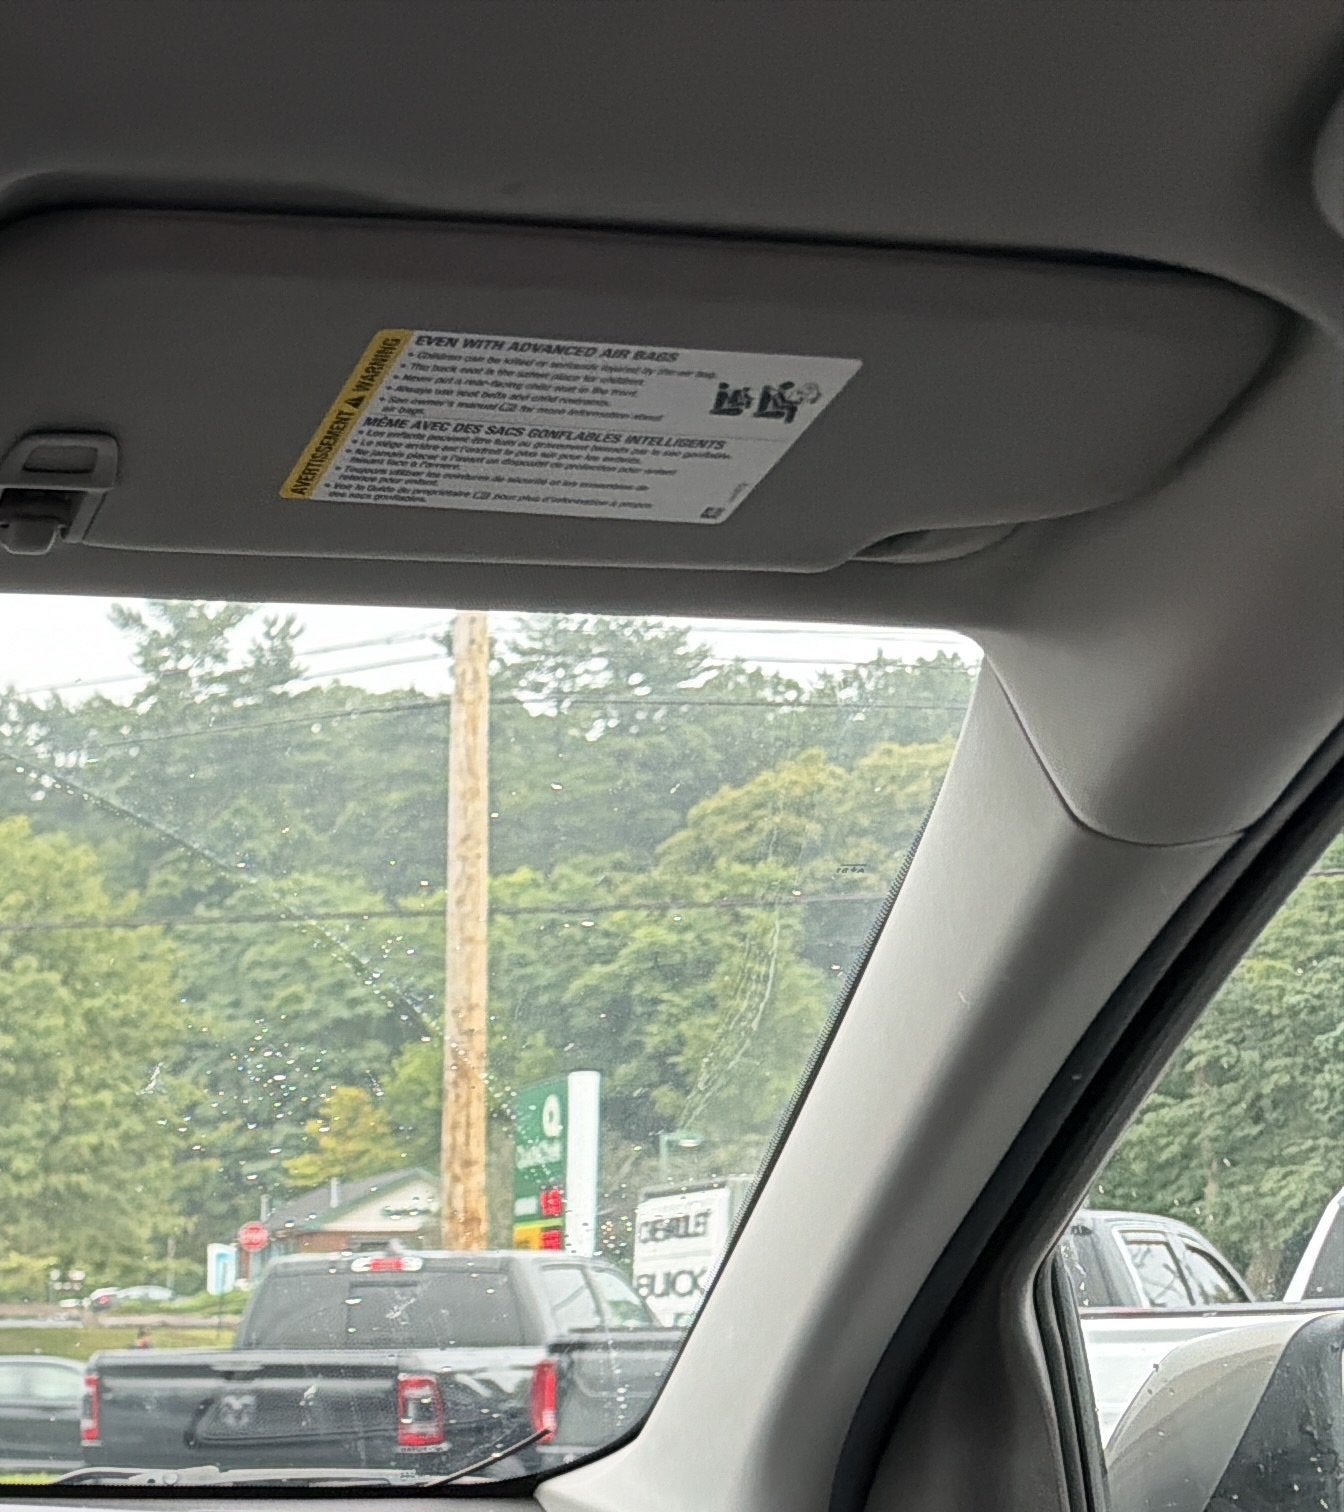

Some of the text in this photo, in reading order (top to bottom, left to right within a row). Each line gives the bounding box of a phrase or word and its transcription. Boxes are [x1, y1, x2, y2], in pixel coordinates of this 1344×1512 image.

[351, 337, 401, 393] WARNING
[415, 335, 680, 362] EVEN WITH ADVANCED AIR BAGS
[291, 410, 354, 495] AVERTISSEMENT
[363, 416, 410, 429] MÊME
[411, 419, 451, 432] AVEC
[453, 423, 484, 434] DES
[485, 425, 524, 437] SACS
[527, 428, 622, 444] GONFLABLES
[625, 434, 727, 450] INTELLIGENTS
